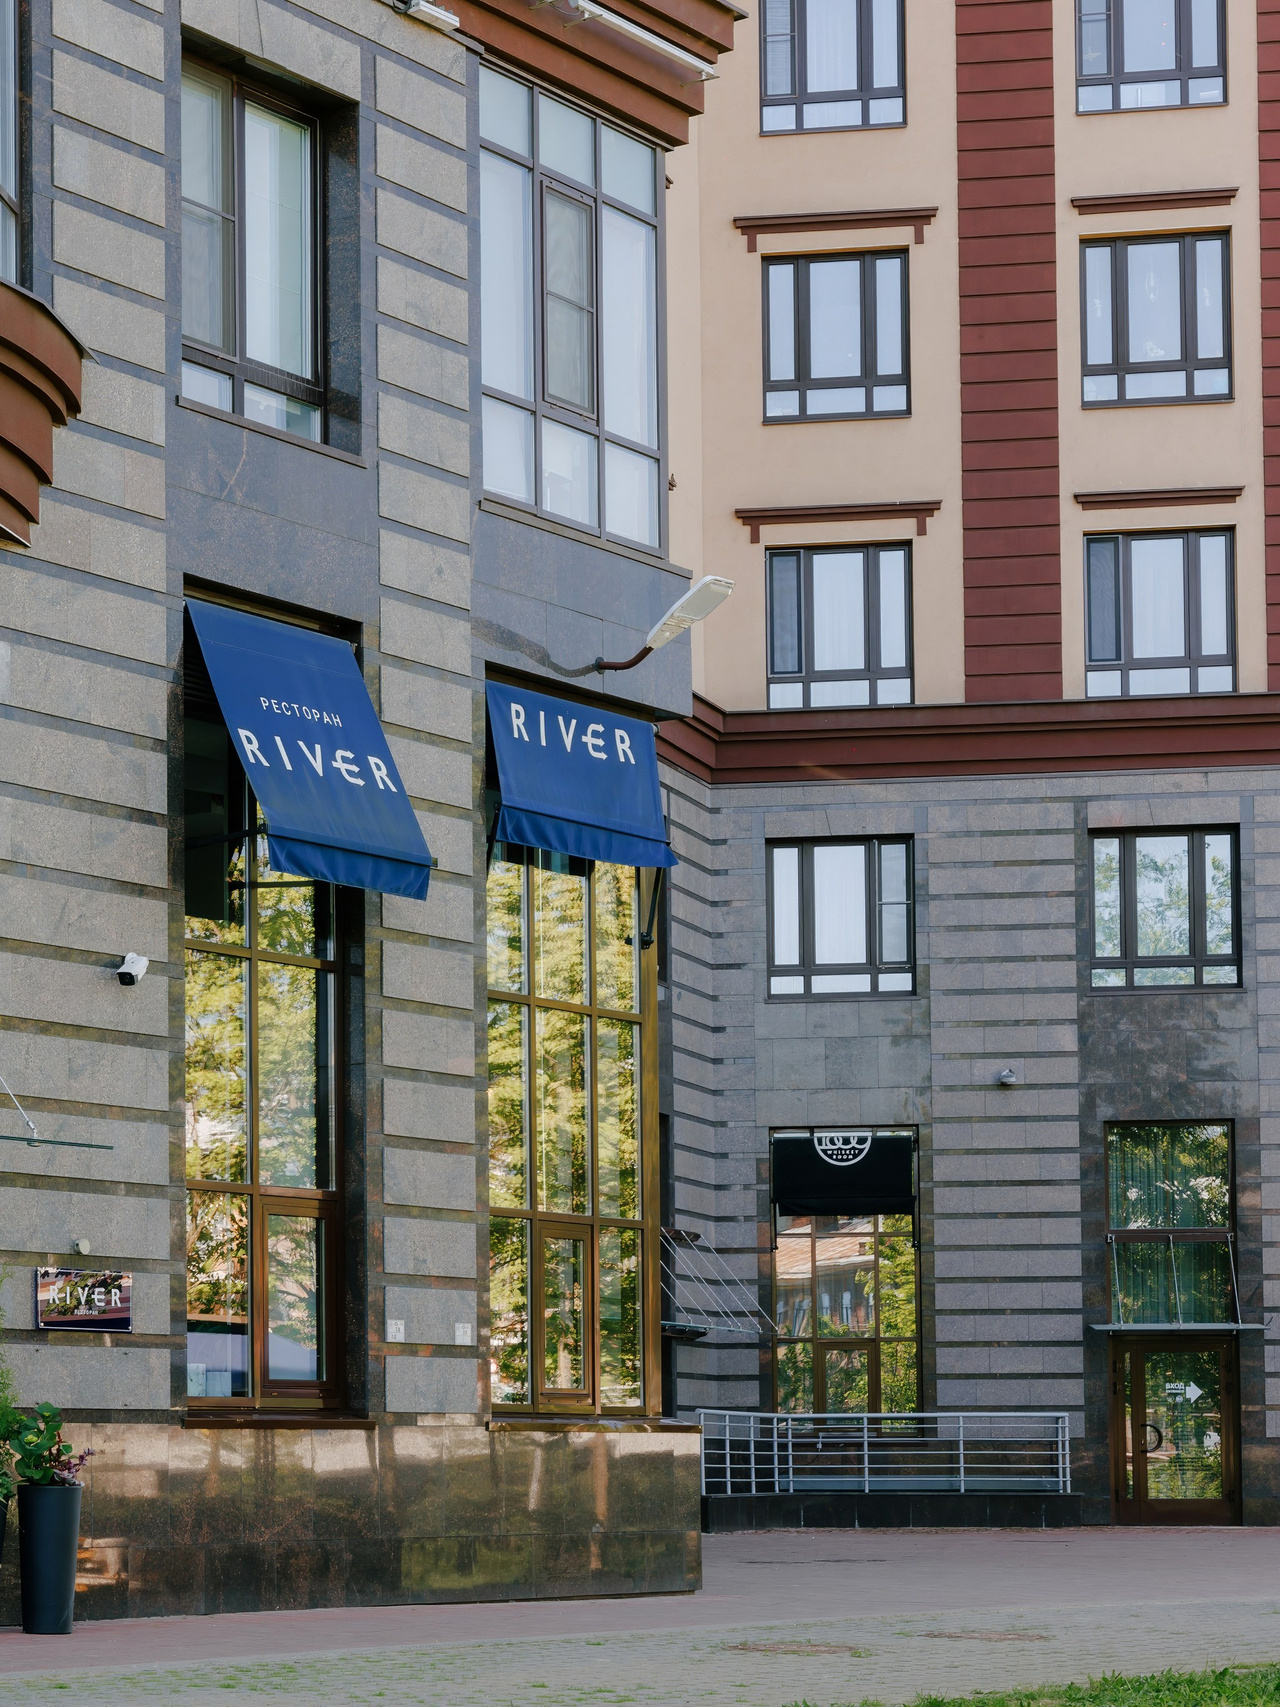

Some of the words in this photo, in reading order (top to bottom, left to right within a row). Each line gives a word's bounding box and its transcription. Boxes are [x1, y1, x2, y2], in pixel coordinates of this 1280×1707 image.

[259, 696, 343, 728] РЕСТОРАН
[510, 702, 636, 765] RIVER
[237, 728, 398, 793] RIVER
[49, 1285, 121, 1307] RIVER
